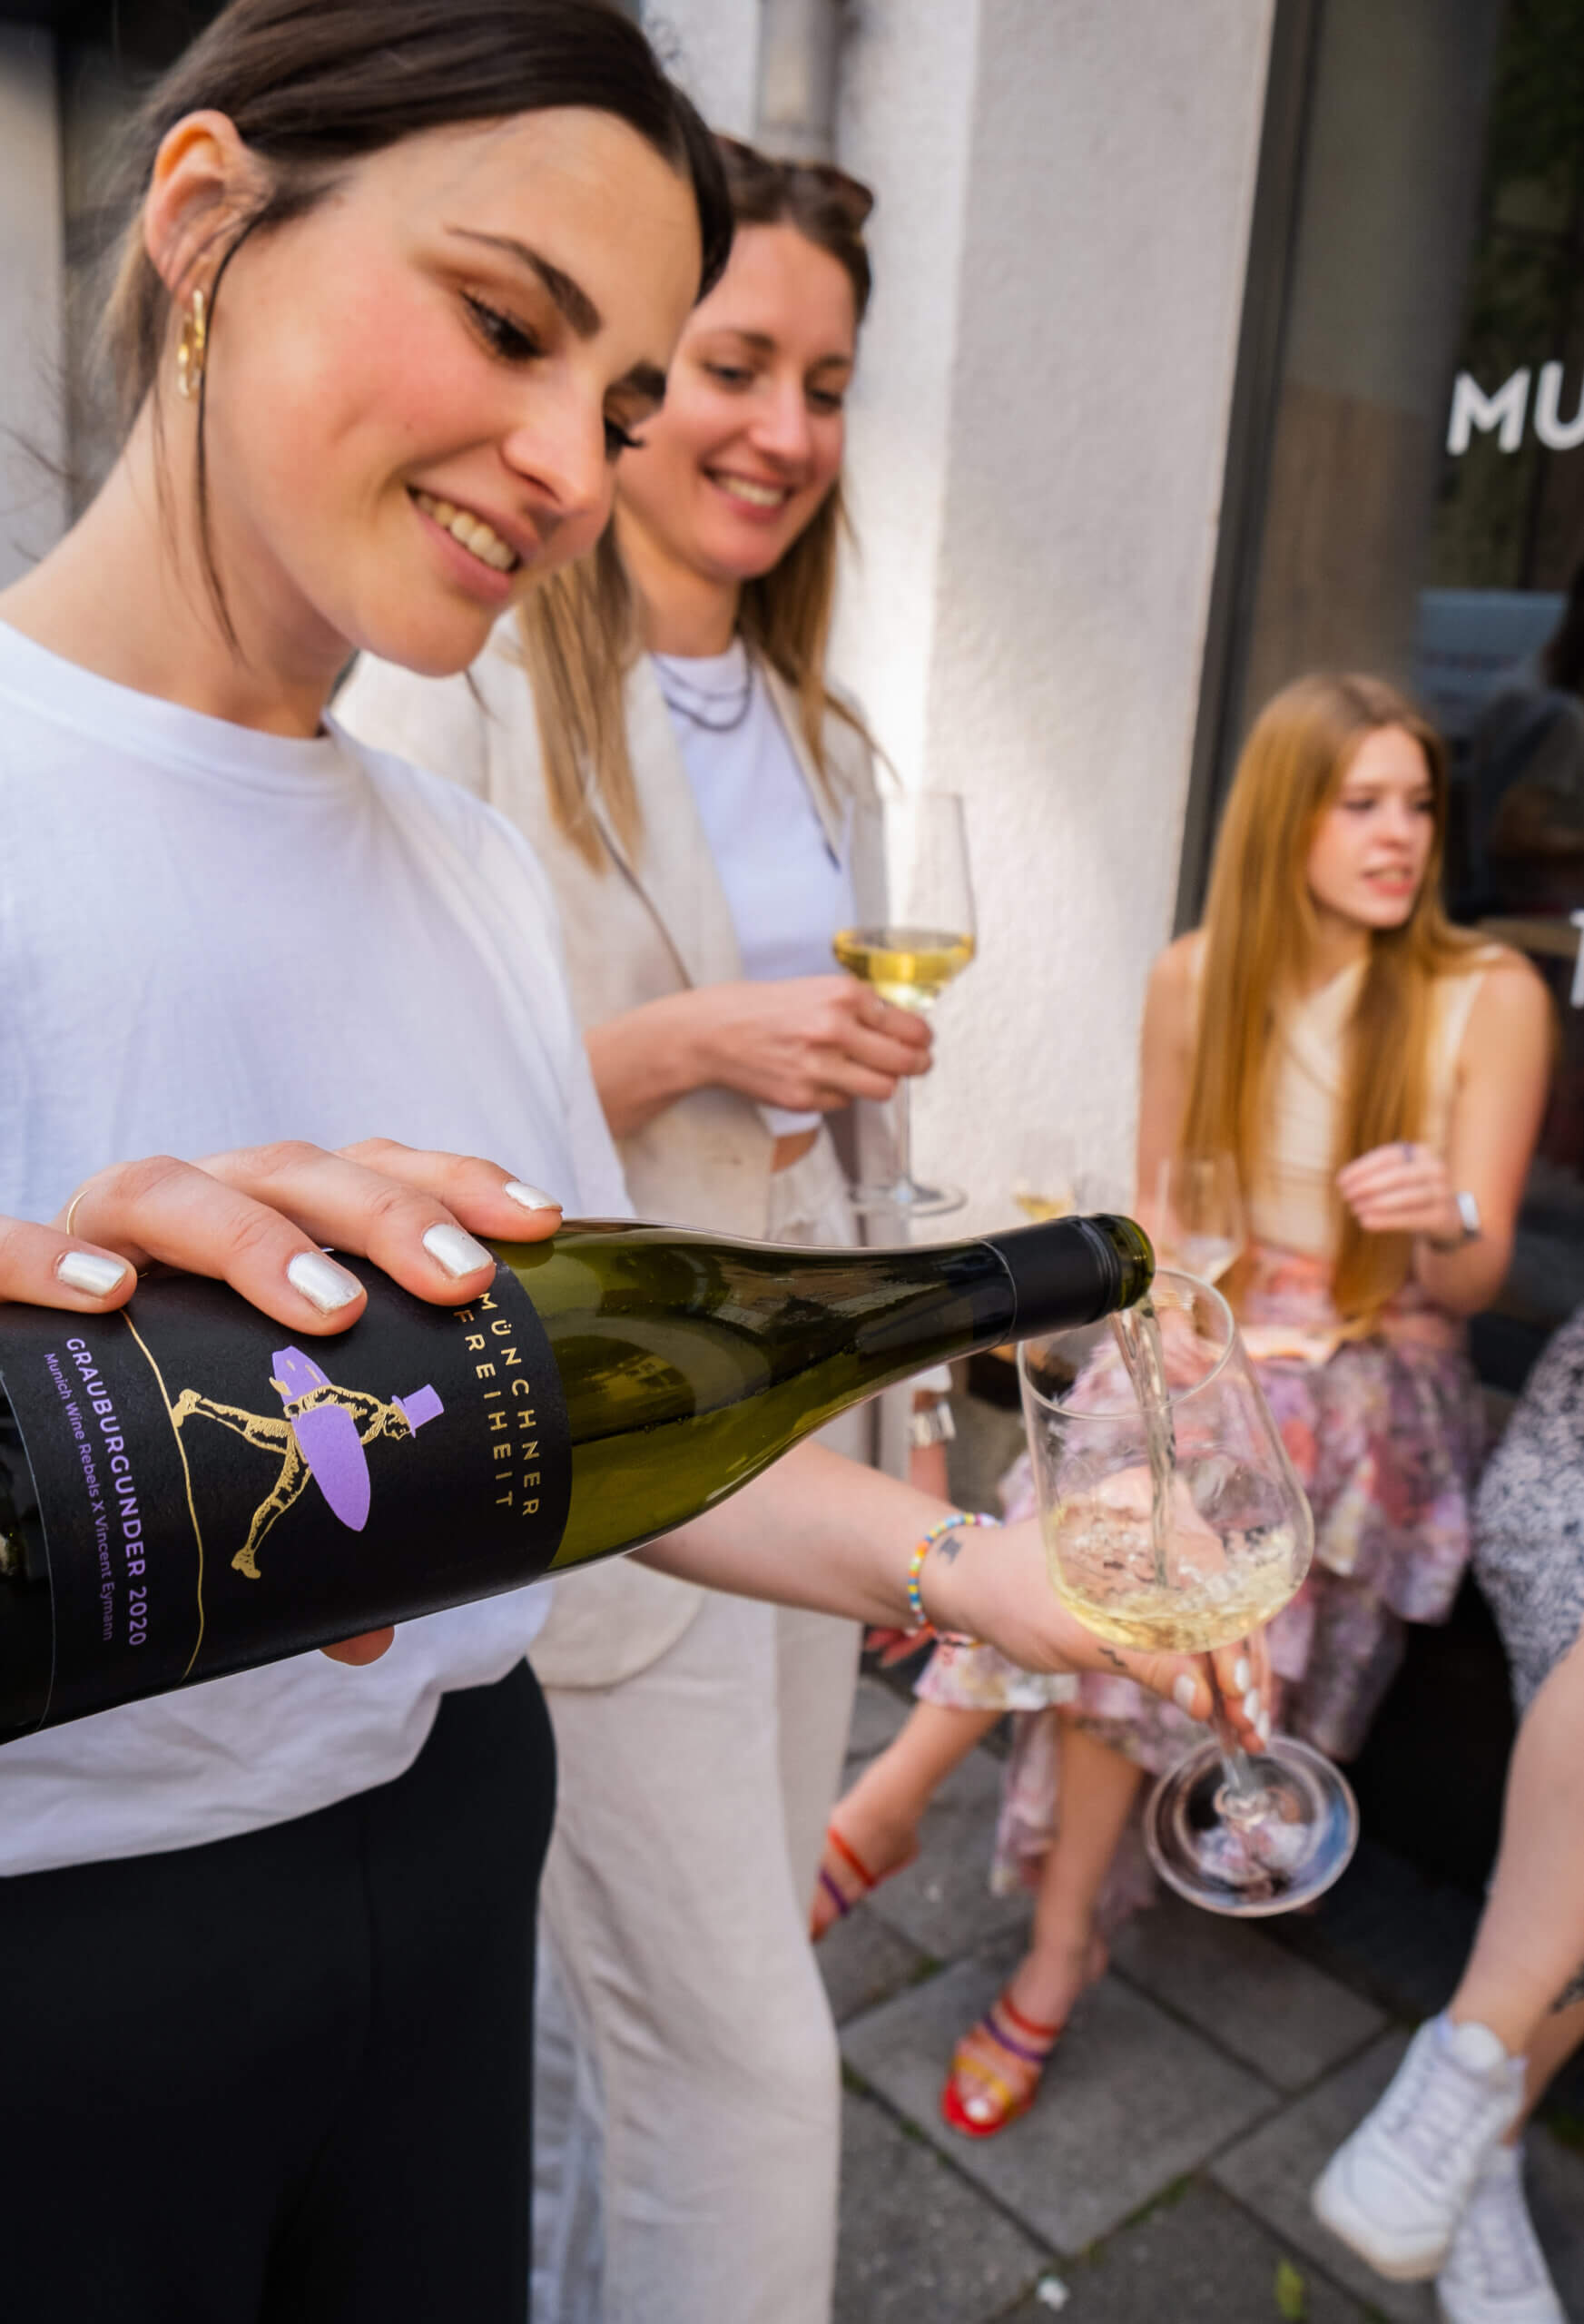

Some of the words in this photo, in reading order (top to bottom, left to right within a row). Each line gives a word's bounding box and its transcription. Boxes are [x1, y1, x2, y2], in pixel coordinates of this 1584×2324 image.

[1447, 359, 1584, 456] MU
[44, 1353, 73, 1400] Munich
[454, 1309, 511, 1507] FREIHEIT
[479, 1292, 540, 1516] MÜNCHNER
[65, 1402, 85, 1440] Wine
[66, 1338, 145, 1577] GRAUBURGUNDER
[129, 1586, 147, 1645] 2020
[79, 1443, 101, 1498] Rebels
[94, 1514, 112, 1579] Vincent
[100, 1581, 115, 1640] Eymann
